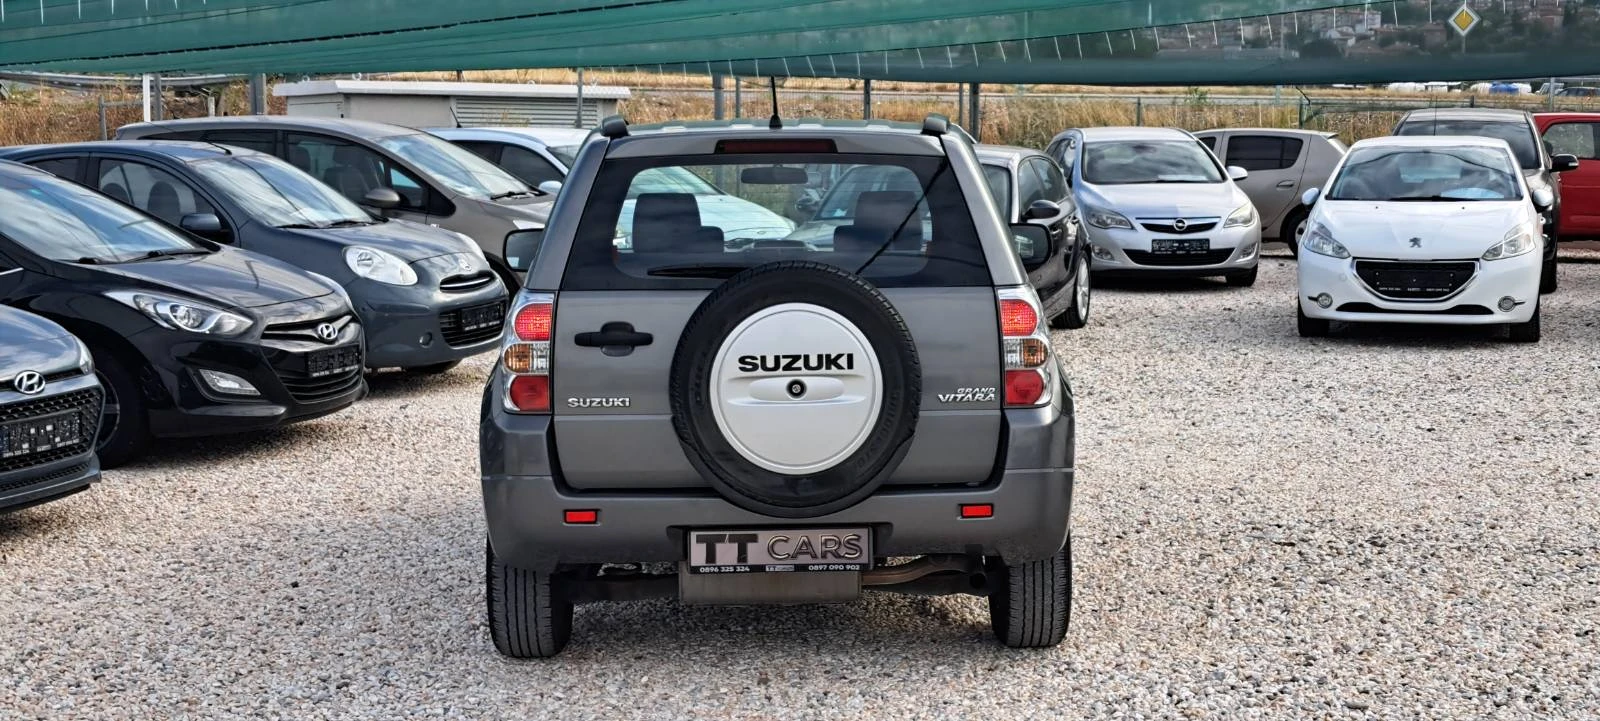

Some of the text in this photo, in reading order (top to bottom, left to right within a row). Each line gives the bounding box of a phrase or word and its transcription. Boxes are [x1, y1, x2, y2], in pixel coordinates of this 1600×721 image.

[738, 353, 854, 372] SUZUKI
[567, 397, 630, 407] SUZUKI
[937, 393, 995, 402] VITARA
[696, 533, 863, 564] TT CARS
